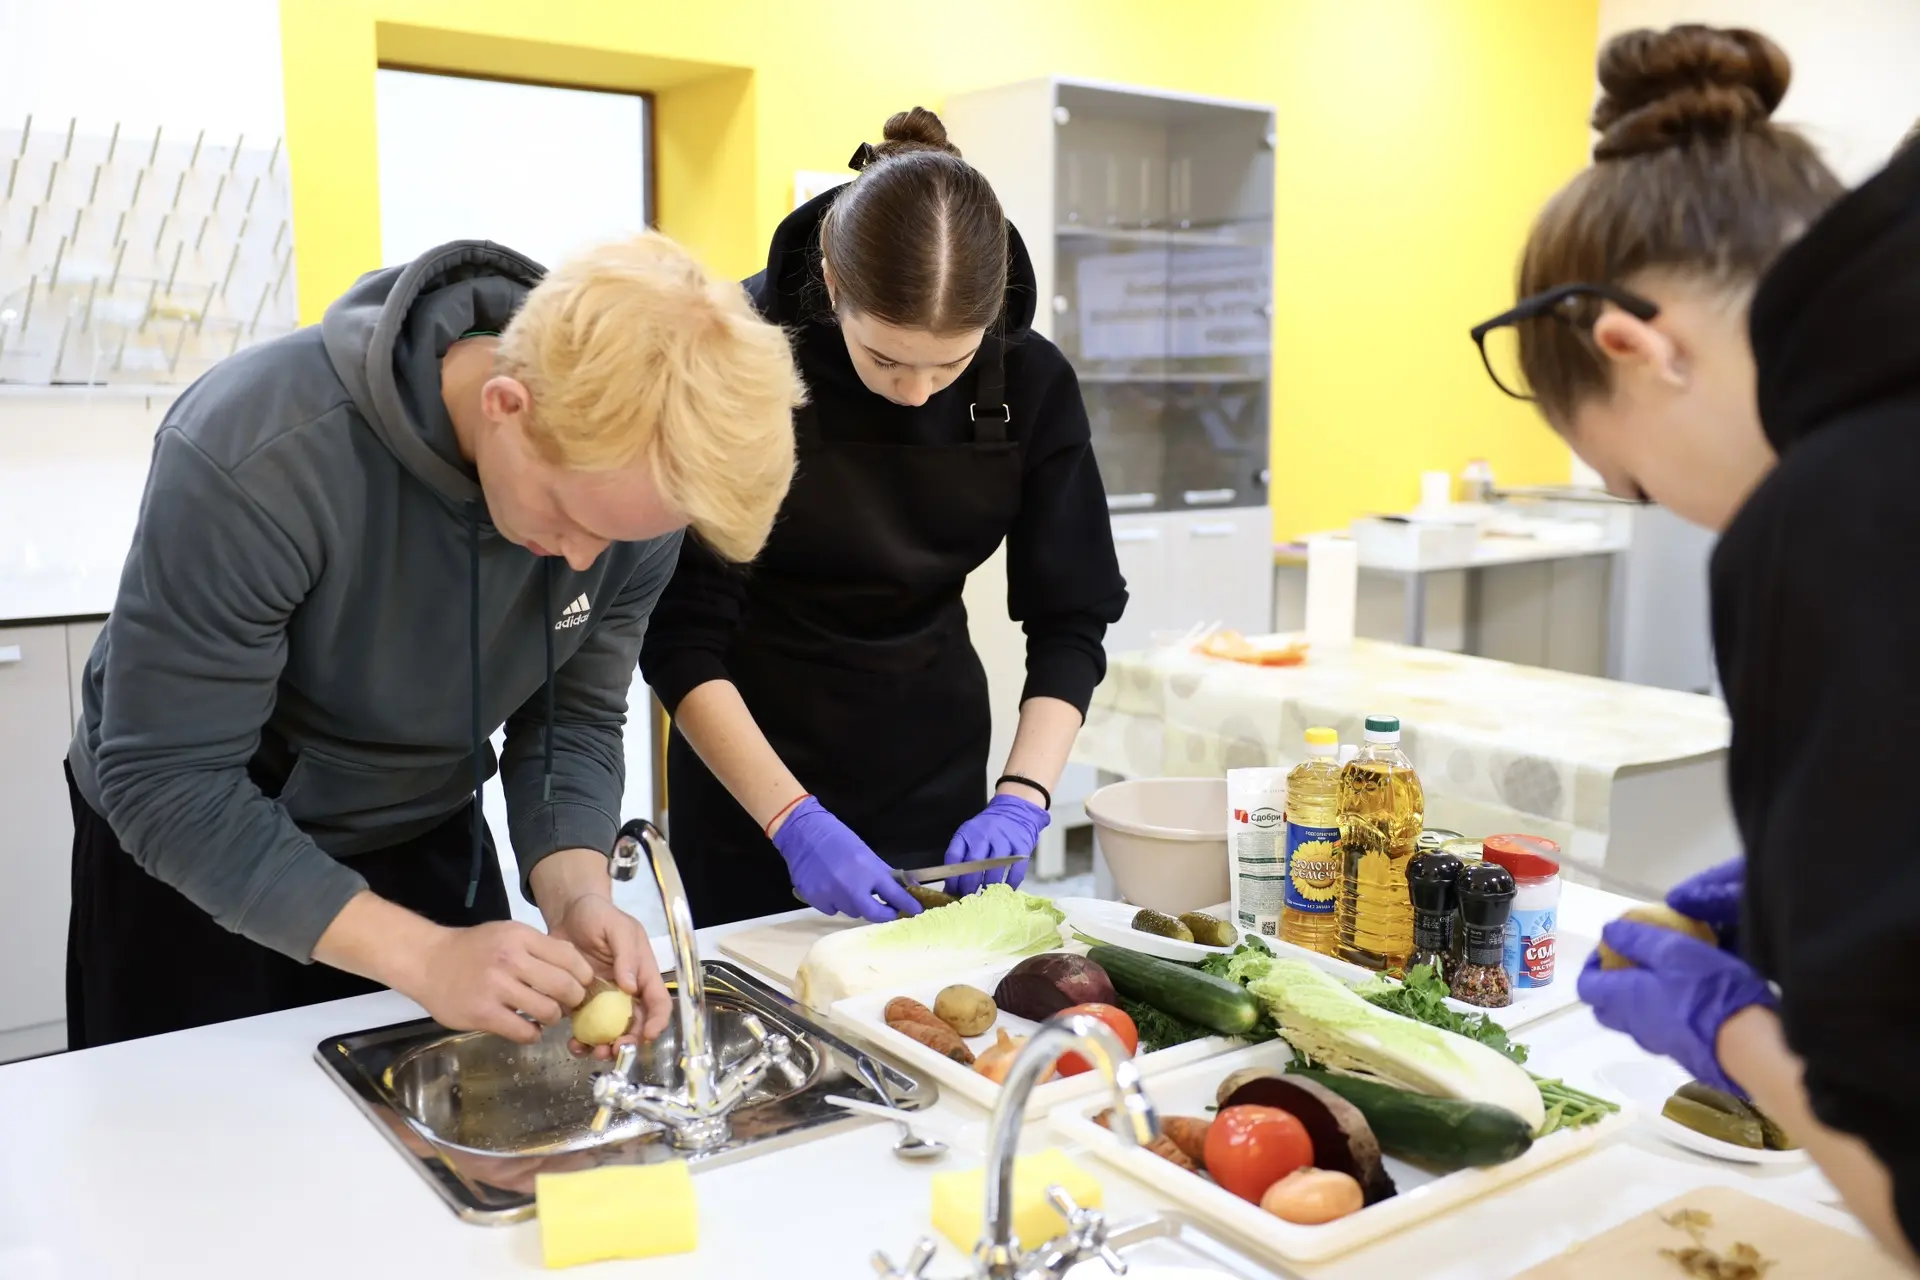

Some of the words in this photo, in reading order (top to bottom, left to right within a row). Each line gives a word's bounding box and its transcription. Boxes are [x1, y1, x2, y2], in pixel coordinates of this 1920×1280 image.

[1250, 813, 1281, 823] Сдобри
[1294, 859, 1337, 871] ЗОЛОТА
[1293, 868, 1336, 881] СЕМЕЧ
[1531, 962, 1554, 972] ЭКСТ
